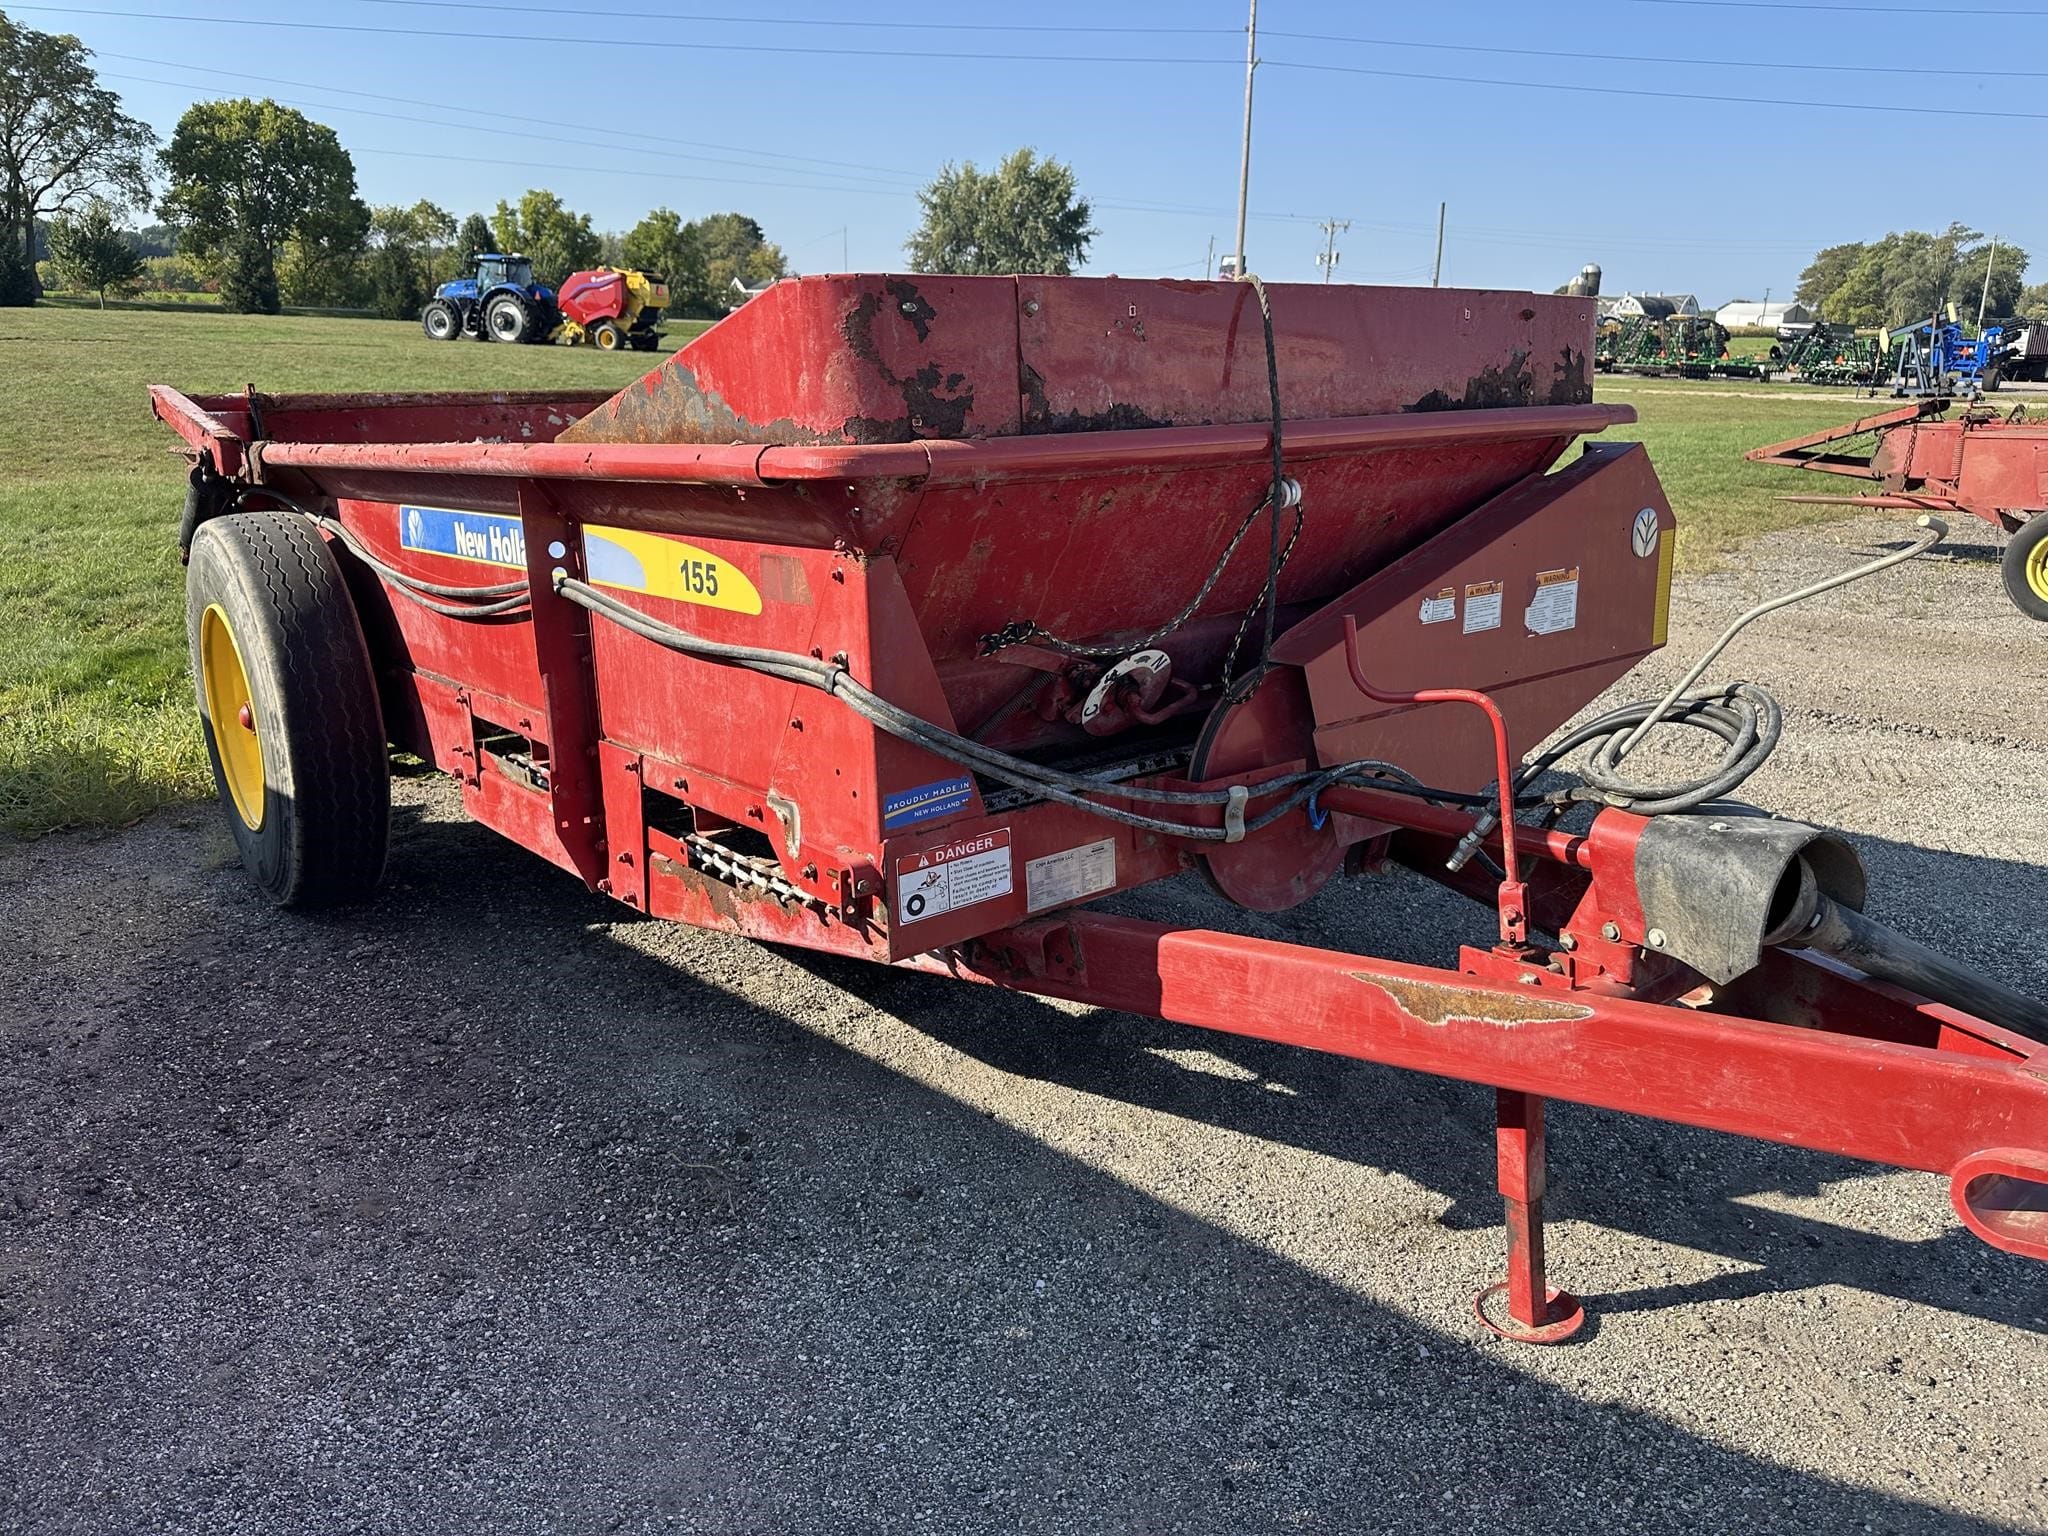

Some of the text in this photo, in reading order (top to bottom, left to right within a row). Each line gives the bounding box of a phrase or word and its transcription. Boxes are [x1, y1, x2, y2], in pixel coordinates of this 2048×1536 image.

[454, 521, 527, 566] New Holla
[680, 559, 718, 596] 155
[887, 793, 930, 812] PROUDLY
[932, 785, 957, 797] MADE
[914, 808, 929, 817] NEW
[930, 800, 961, 813] HOLLAND
[935, 837, 993, 863] DANGER
